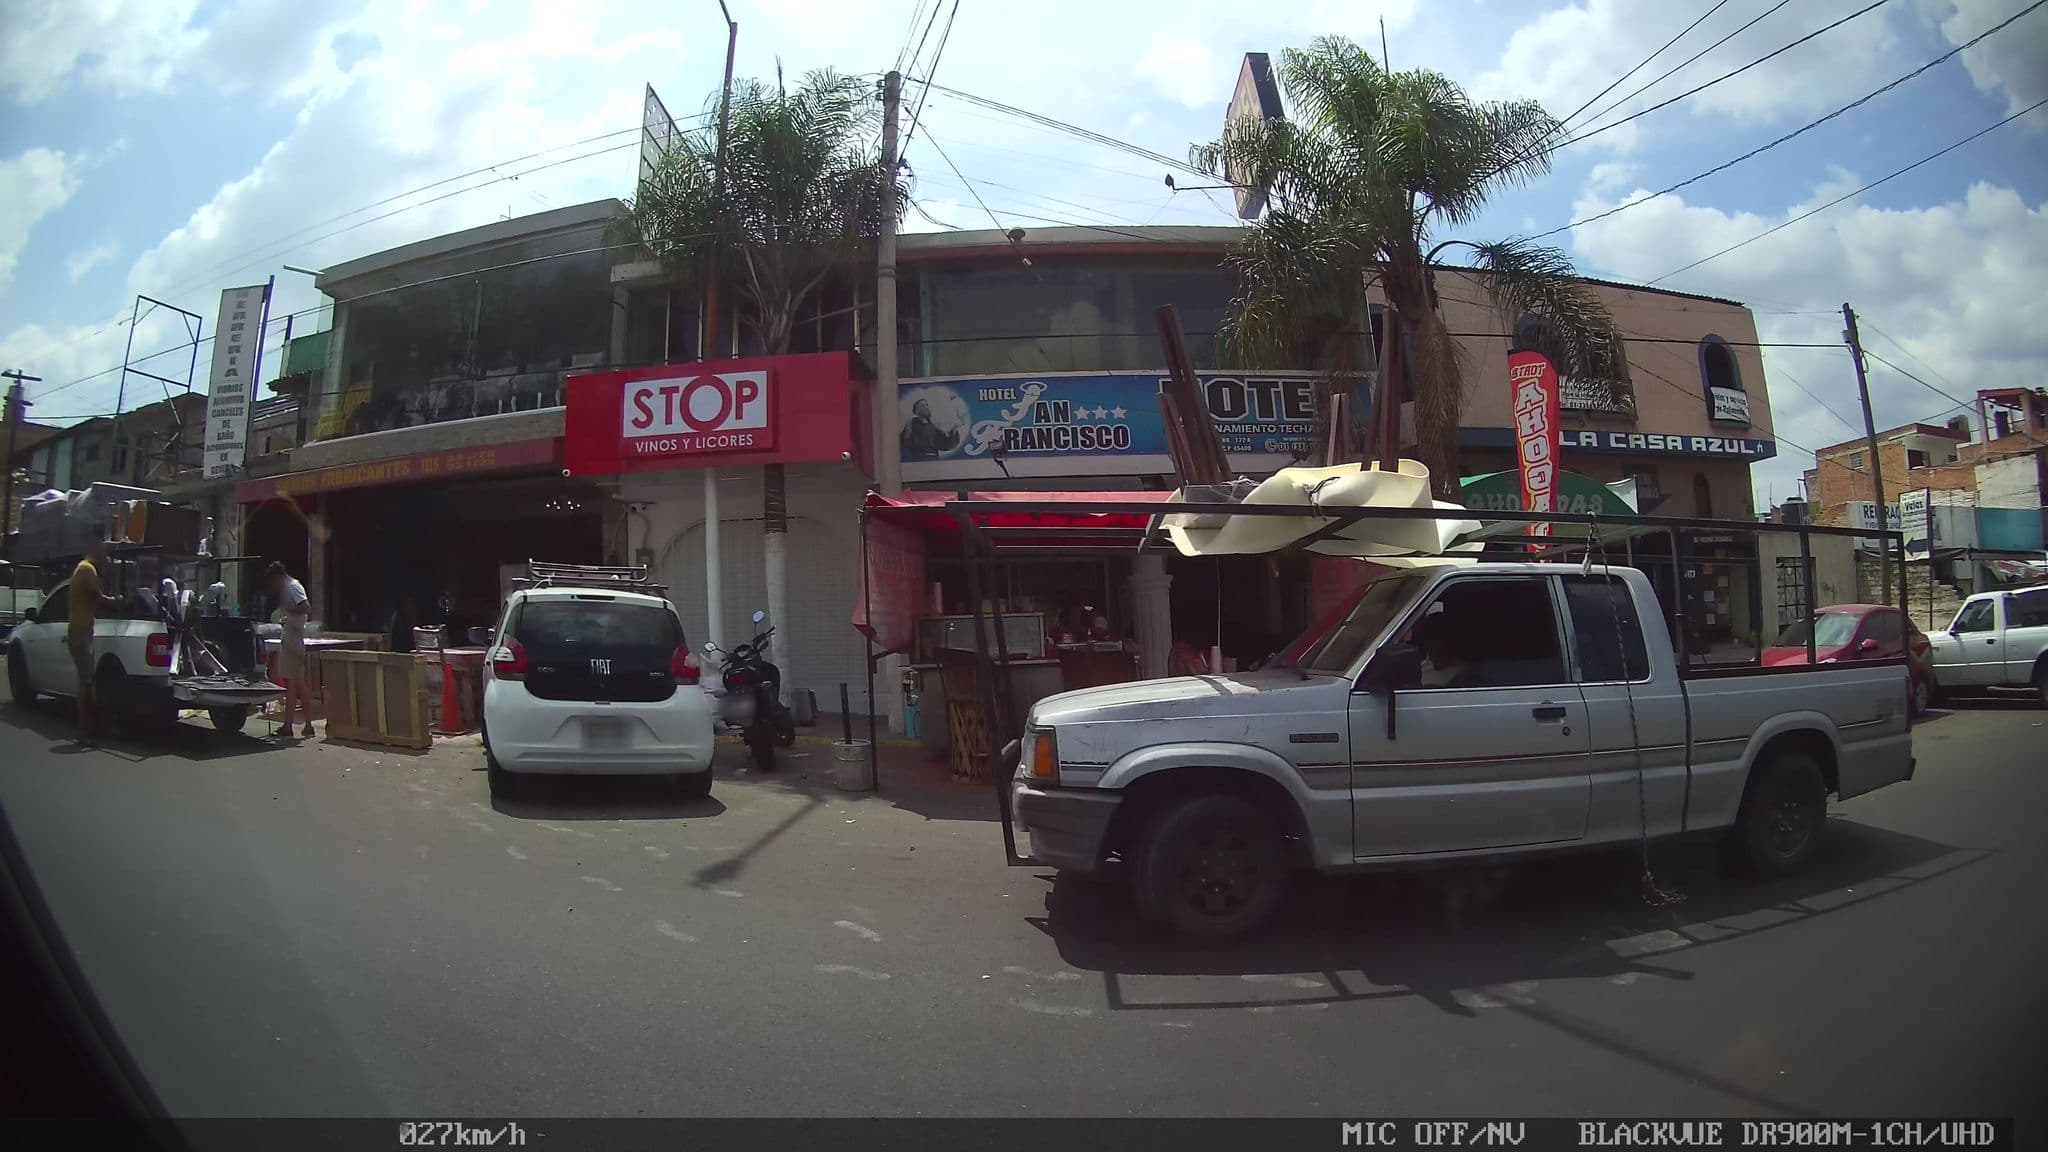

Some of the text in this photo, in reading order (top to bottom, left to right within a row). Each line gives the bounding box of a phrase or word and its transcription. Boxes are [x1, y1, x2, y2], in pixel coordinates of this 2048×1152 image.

[631, 375, 759, 432] STOP
[979, 387, 1017, 401] HOTEL
[1002, 382, 1070, 425] SAN
[635, 433, 754, 453] VINOS Y LICORES
[965, 419, 1131, 455] FRANCISCO
[1559, 430, 1755, 454] LA CASA AZUL
[590, 658, 612, 675] FIAT
